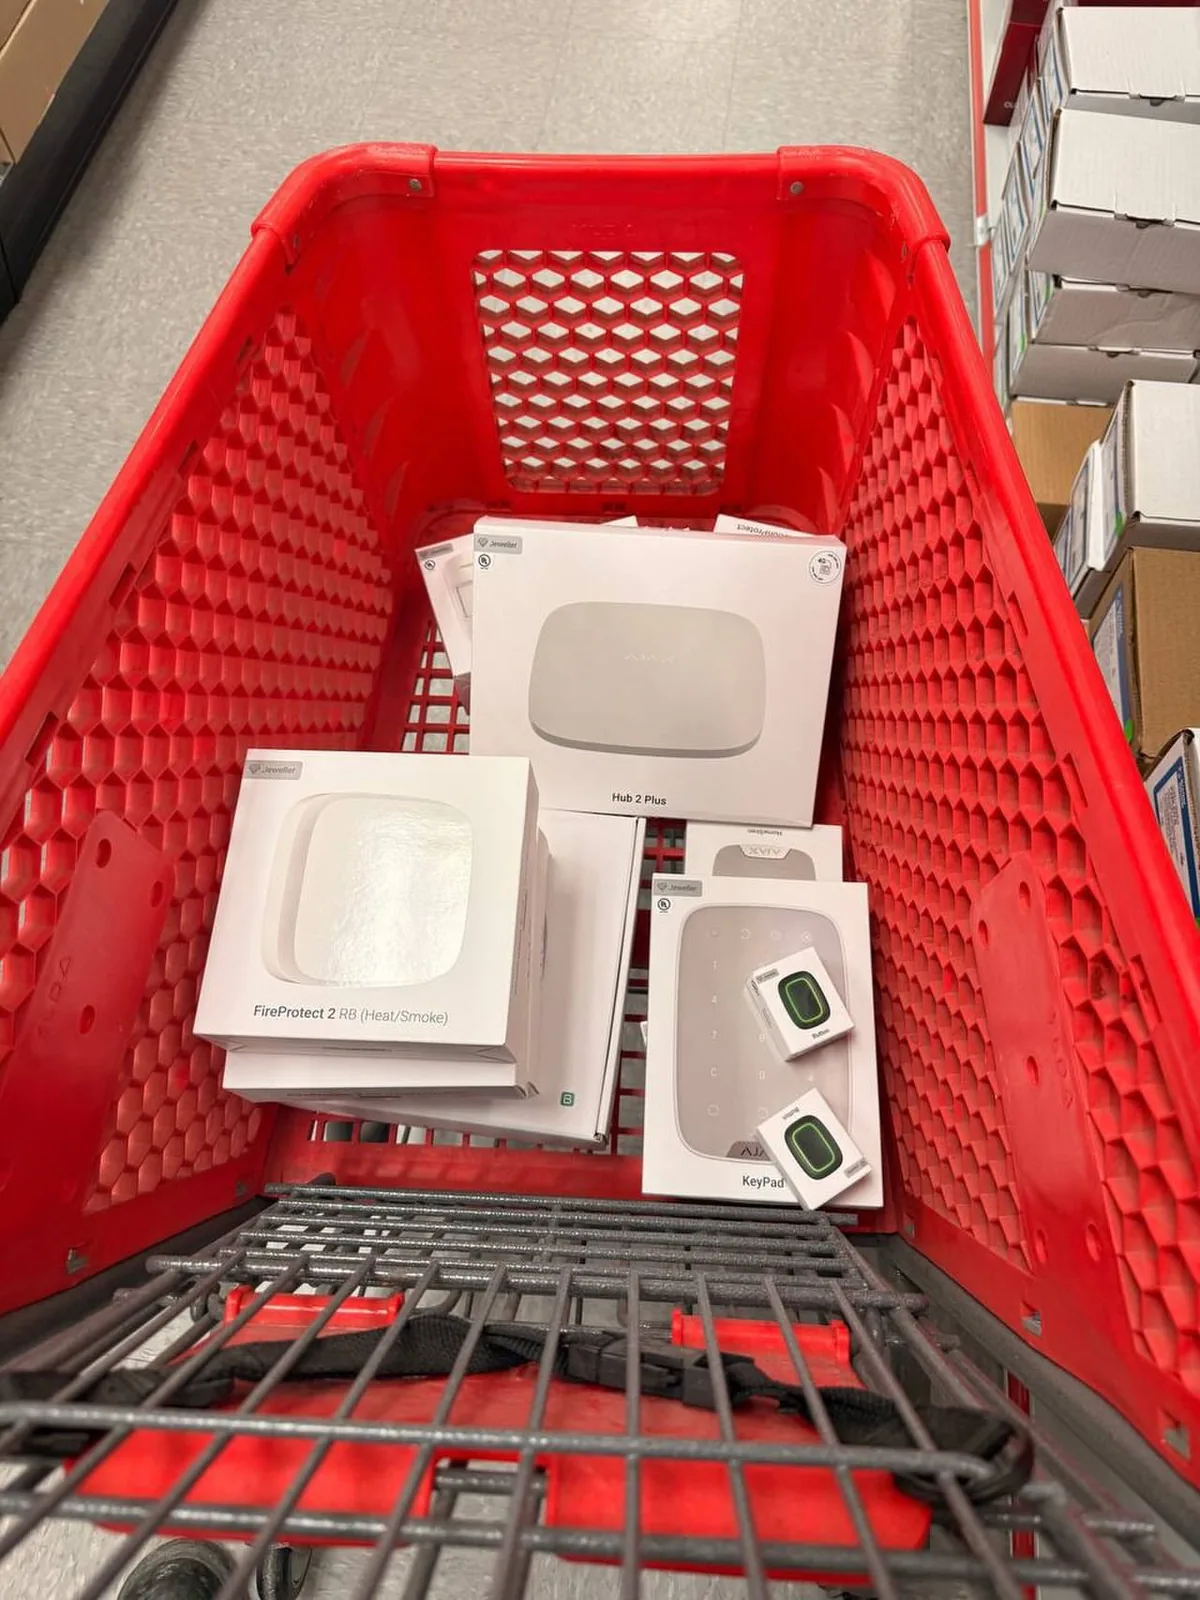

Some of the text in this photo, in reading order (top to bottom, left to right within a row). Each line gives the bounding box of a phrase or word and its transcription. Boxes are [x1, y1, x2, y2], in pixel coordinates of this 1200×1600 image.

[612, 793, 668, 806] Hub 2 Plus
[253, 1004, 449, 1027] FireProtect 2 RB (Heat/Smoke)
[742, 1174, 786, 1190] KeyPad
